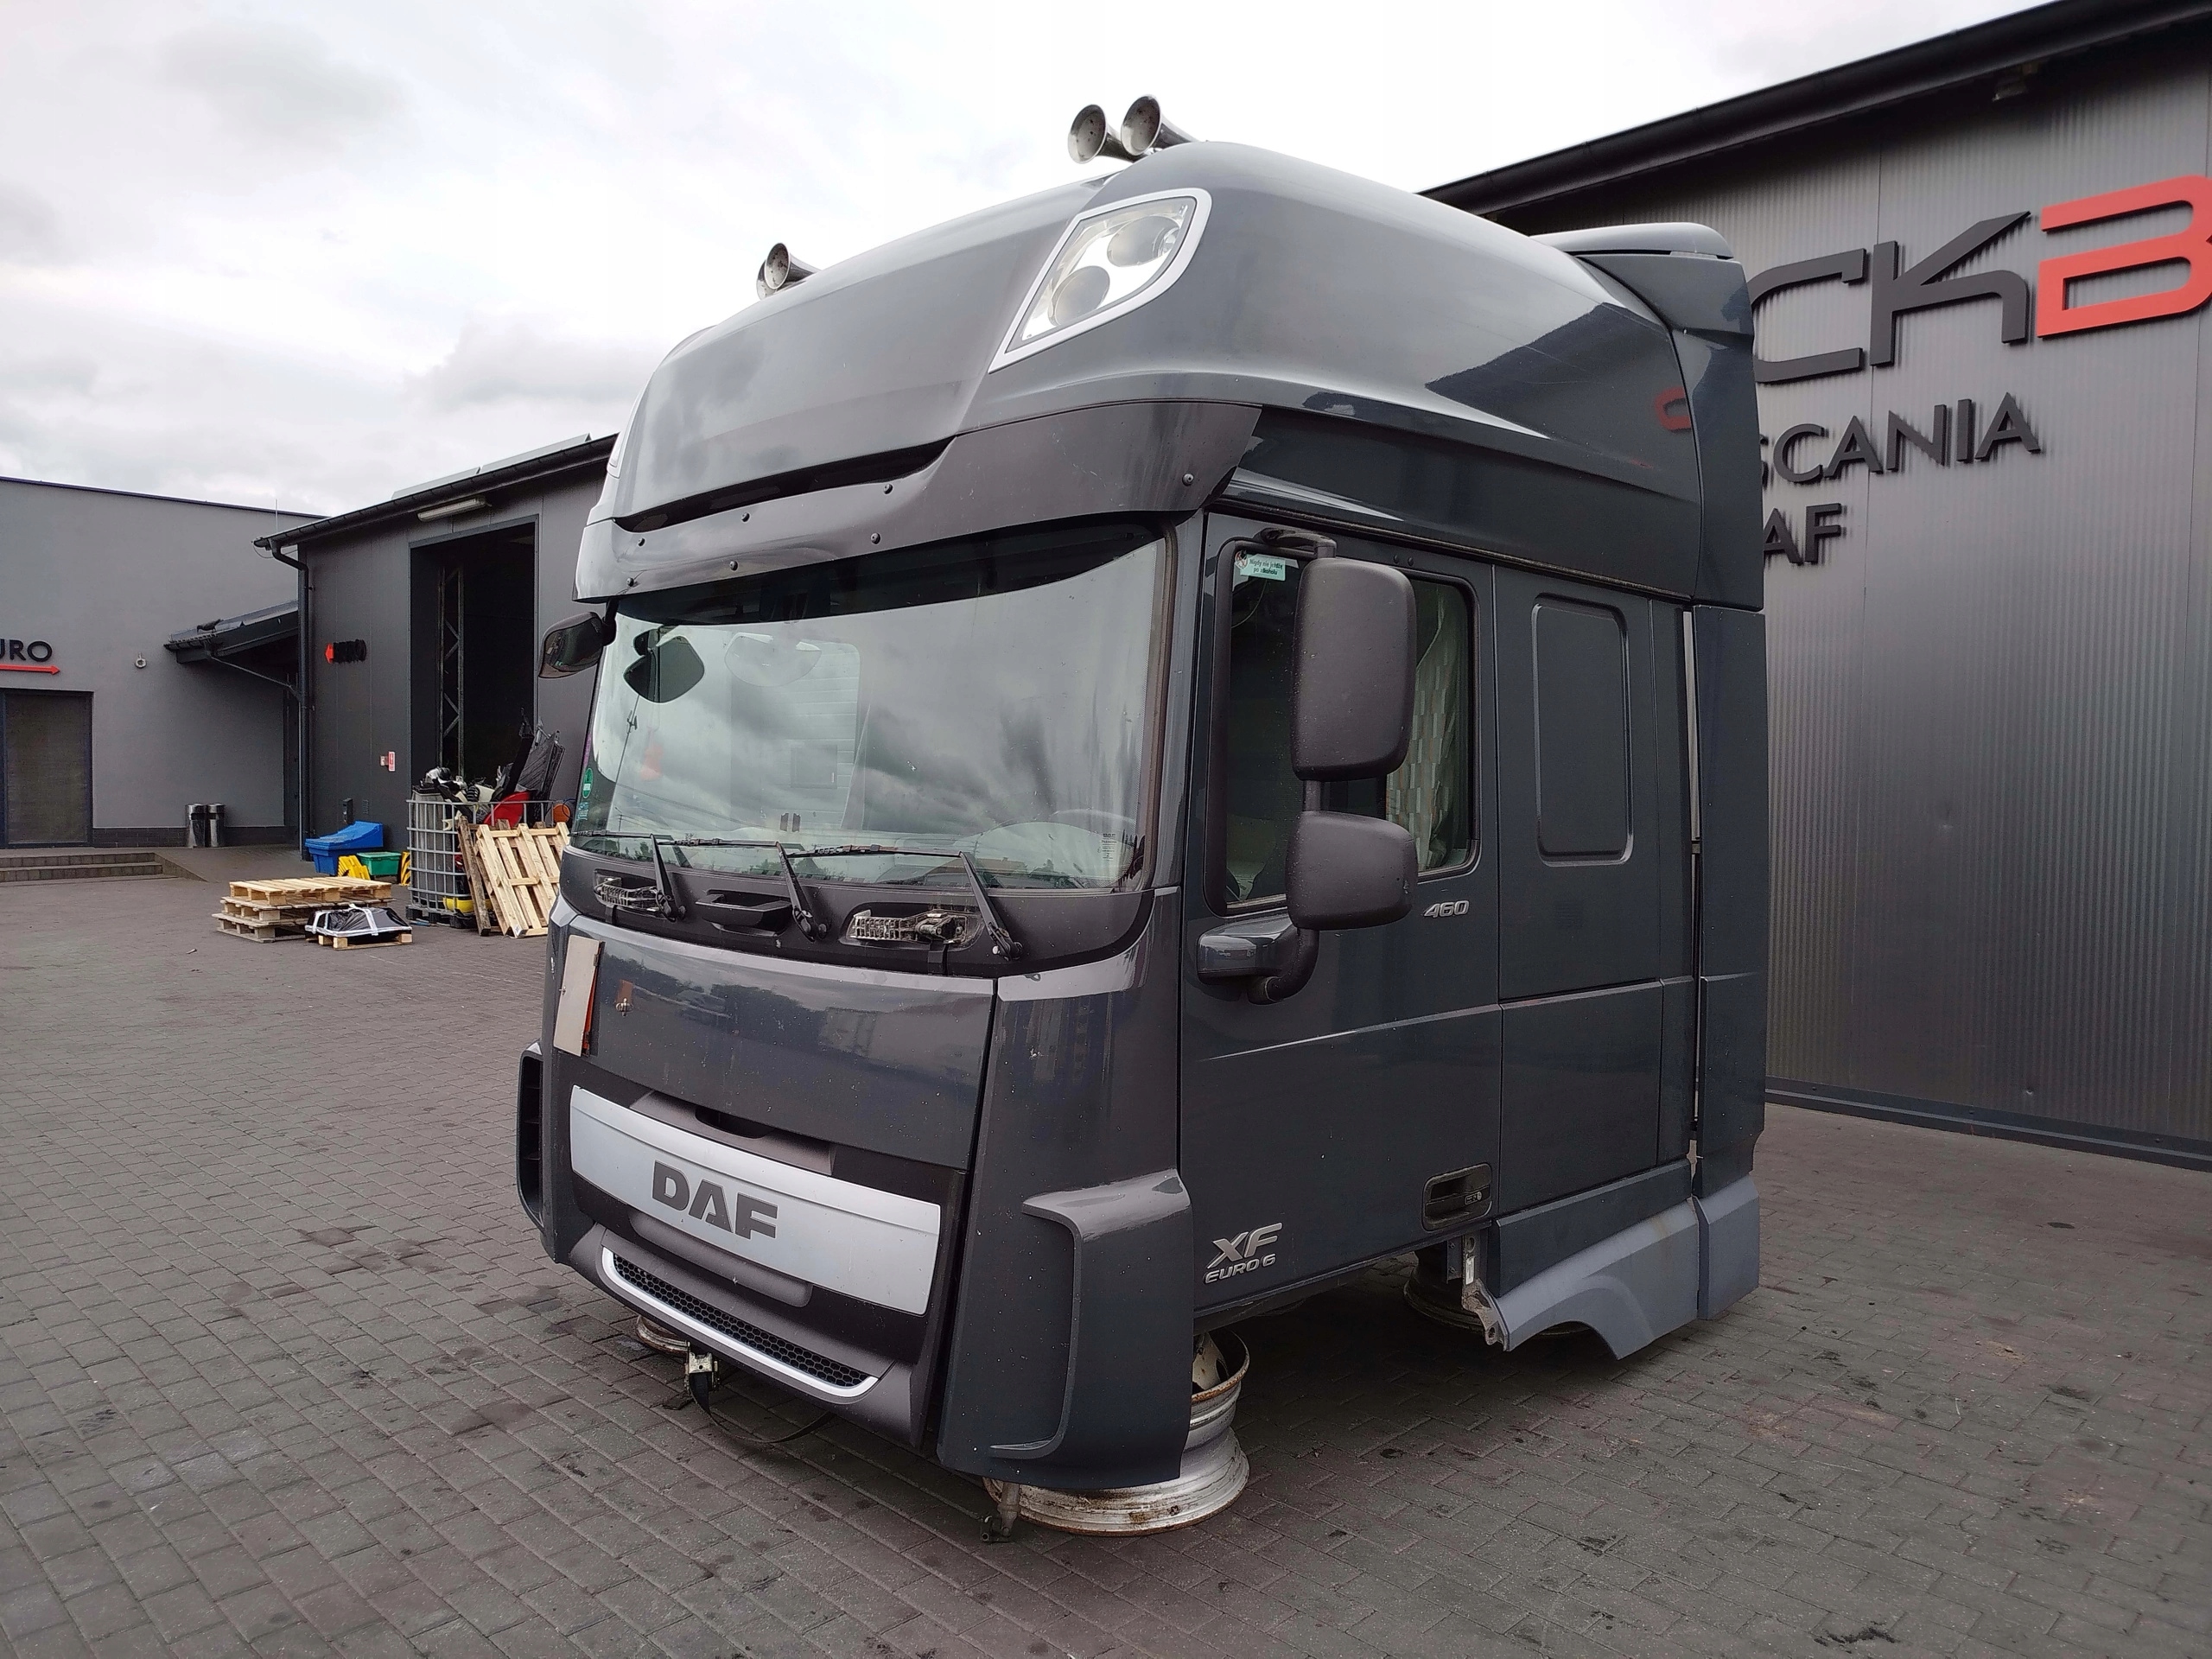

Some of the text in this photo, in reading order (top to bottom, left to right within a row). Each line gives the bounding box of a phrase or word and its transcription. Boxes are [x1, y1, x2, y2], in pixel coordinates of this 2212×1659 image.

[1759, 391, 2041, 487] CANIA
[1423, 900, 1470, 918] 460
[652, 1160, 779, 1241] DAF
[1205, 1253, 1276, 1284] EURO 6
[1207, 1223, 1282, 1269] XF
